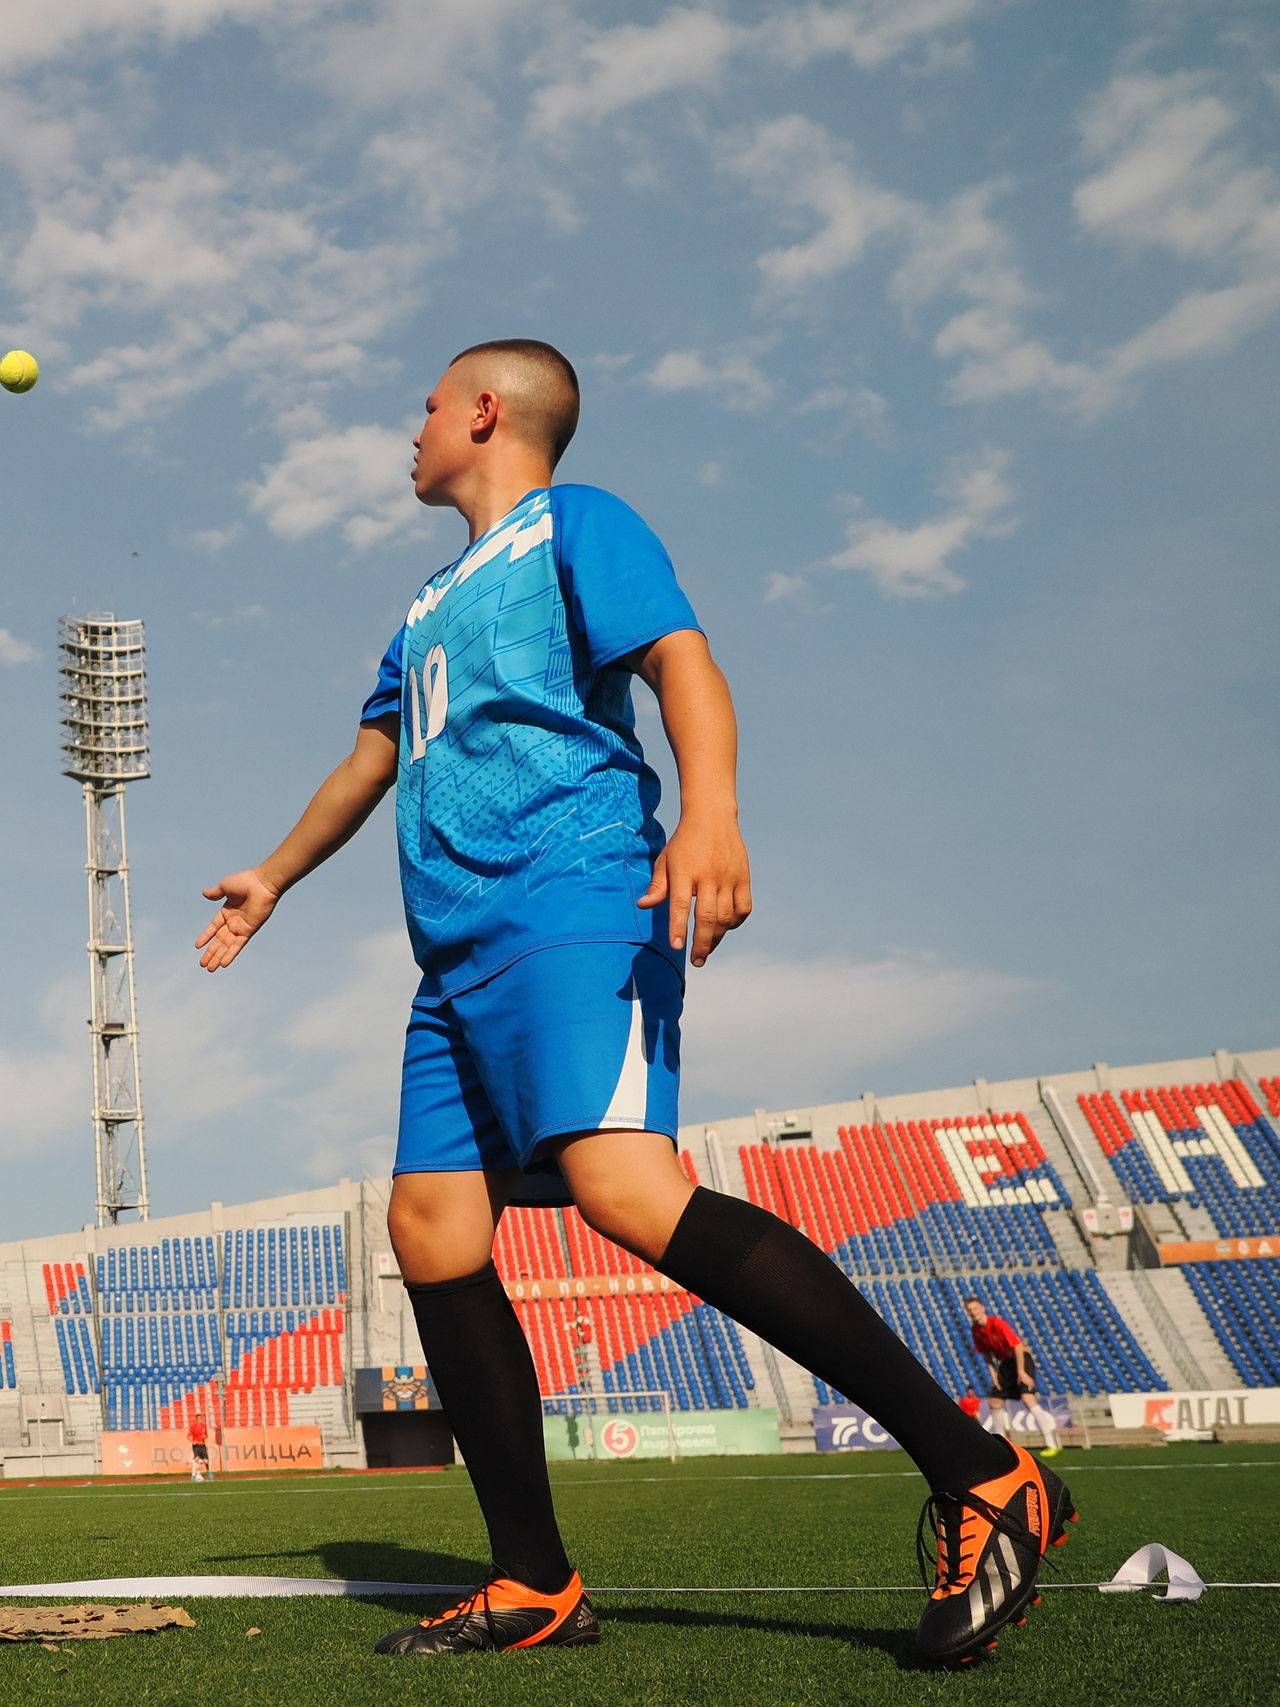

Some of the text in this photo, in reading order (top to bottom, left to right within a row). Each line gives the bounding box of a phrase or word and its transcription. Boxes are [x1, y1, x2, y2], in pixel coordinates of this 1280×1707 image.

[409, 641, 449, 766] 10
[504, 1283, 542, 1298] ОЛ
[1177, 1396, 1248, 1430] АГАТ
[154, 1442, 312, 1466] ДОО ПИЦЦА
[641, 1436, 718, 1451] вырчает!
